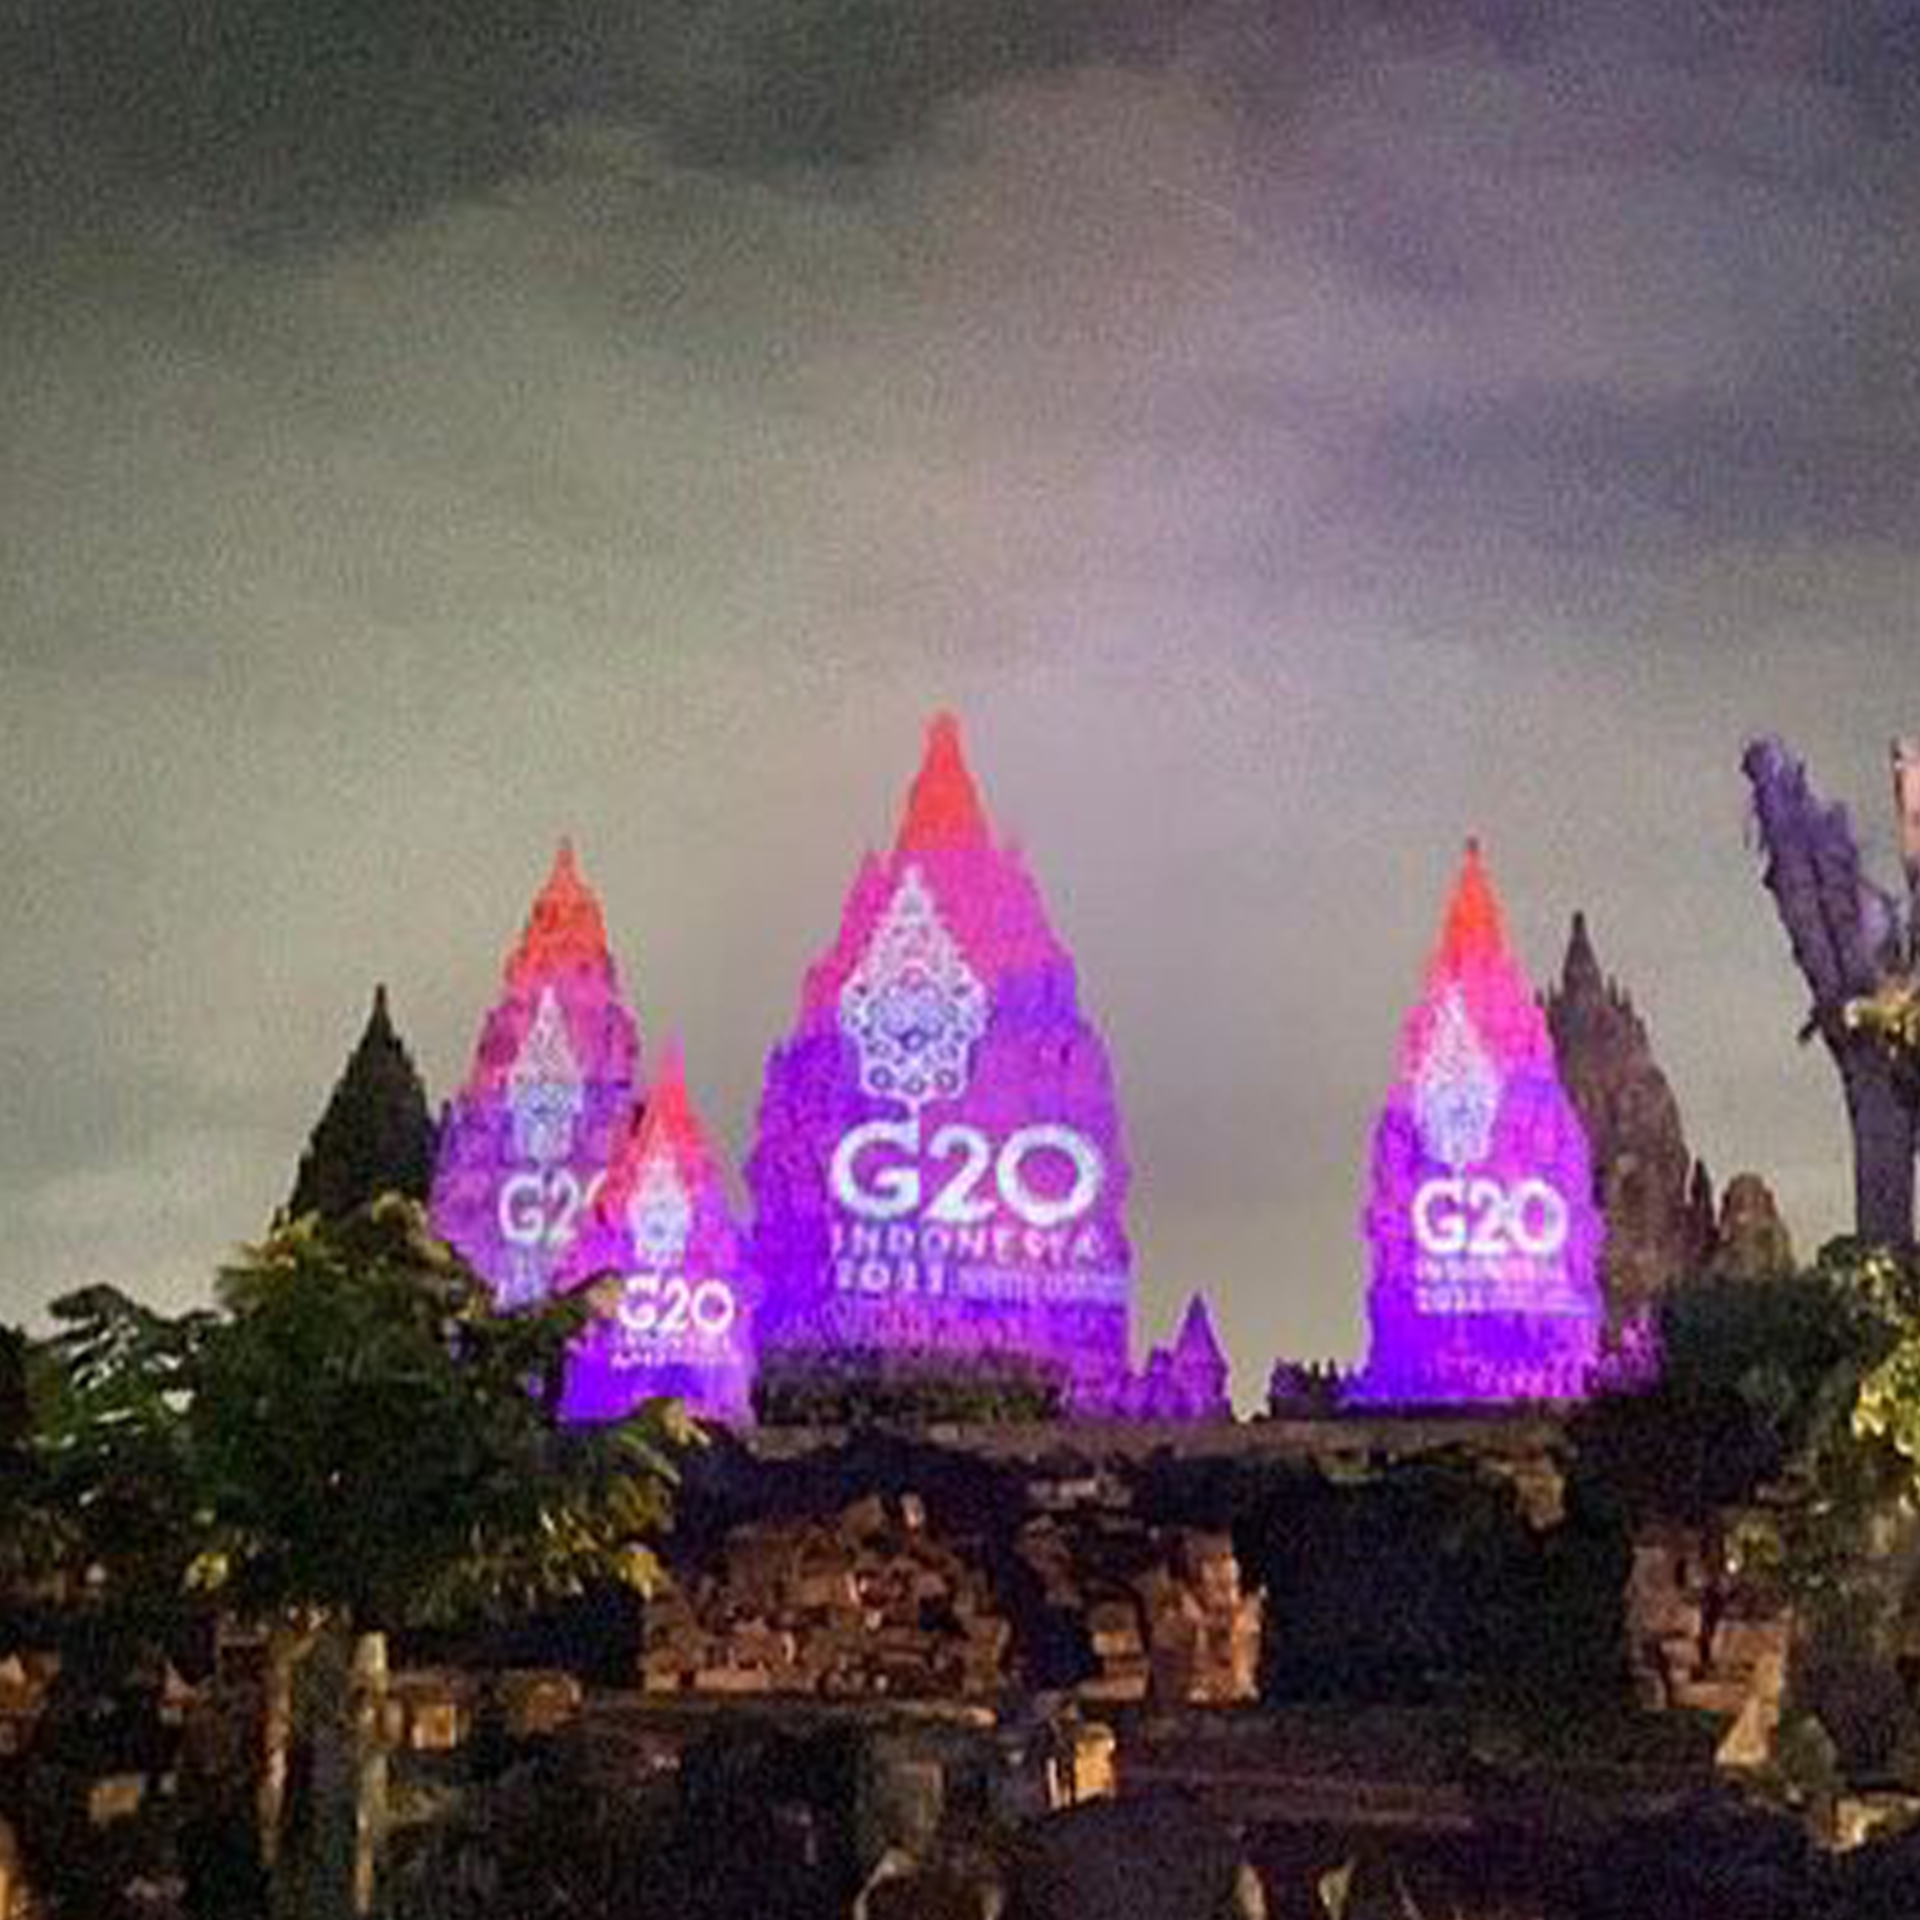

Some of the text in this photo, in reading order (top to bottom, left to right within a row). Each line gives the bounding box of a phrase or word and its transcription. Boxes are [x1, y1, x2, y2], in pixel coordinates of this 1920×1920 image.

[499, 1168, 608, 1242] G2
[829, 1120, 1101, 1226] G20
[1413, 1178, 1567, 1257] G20
[617, 1274, 735, 1334] G20
